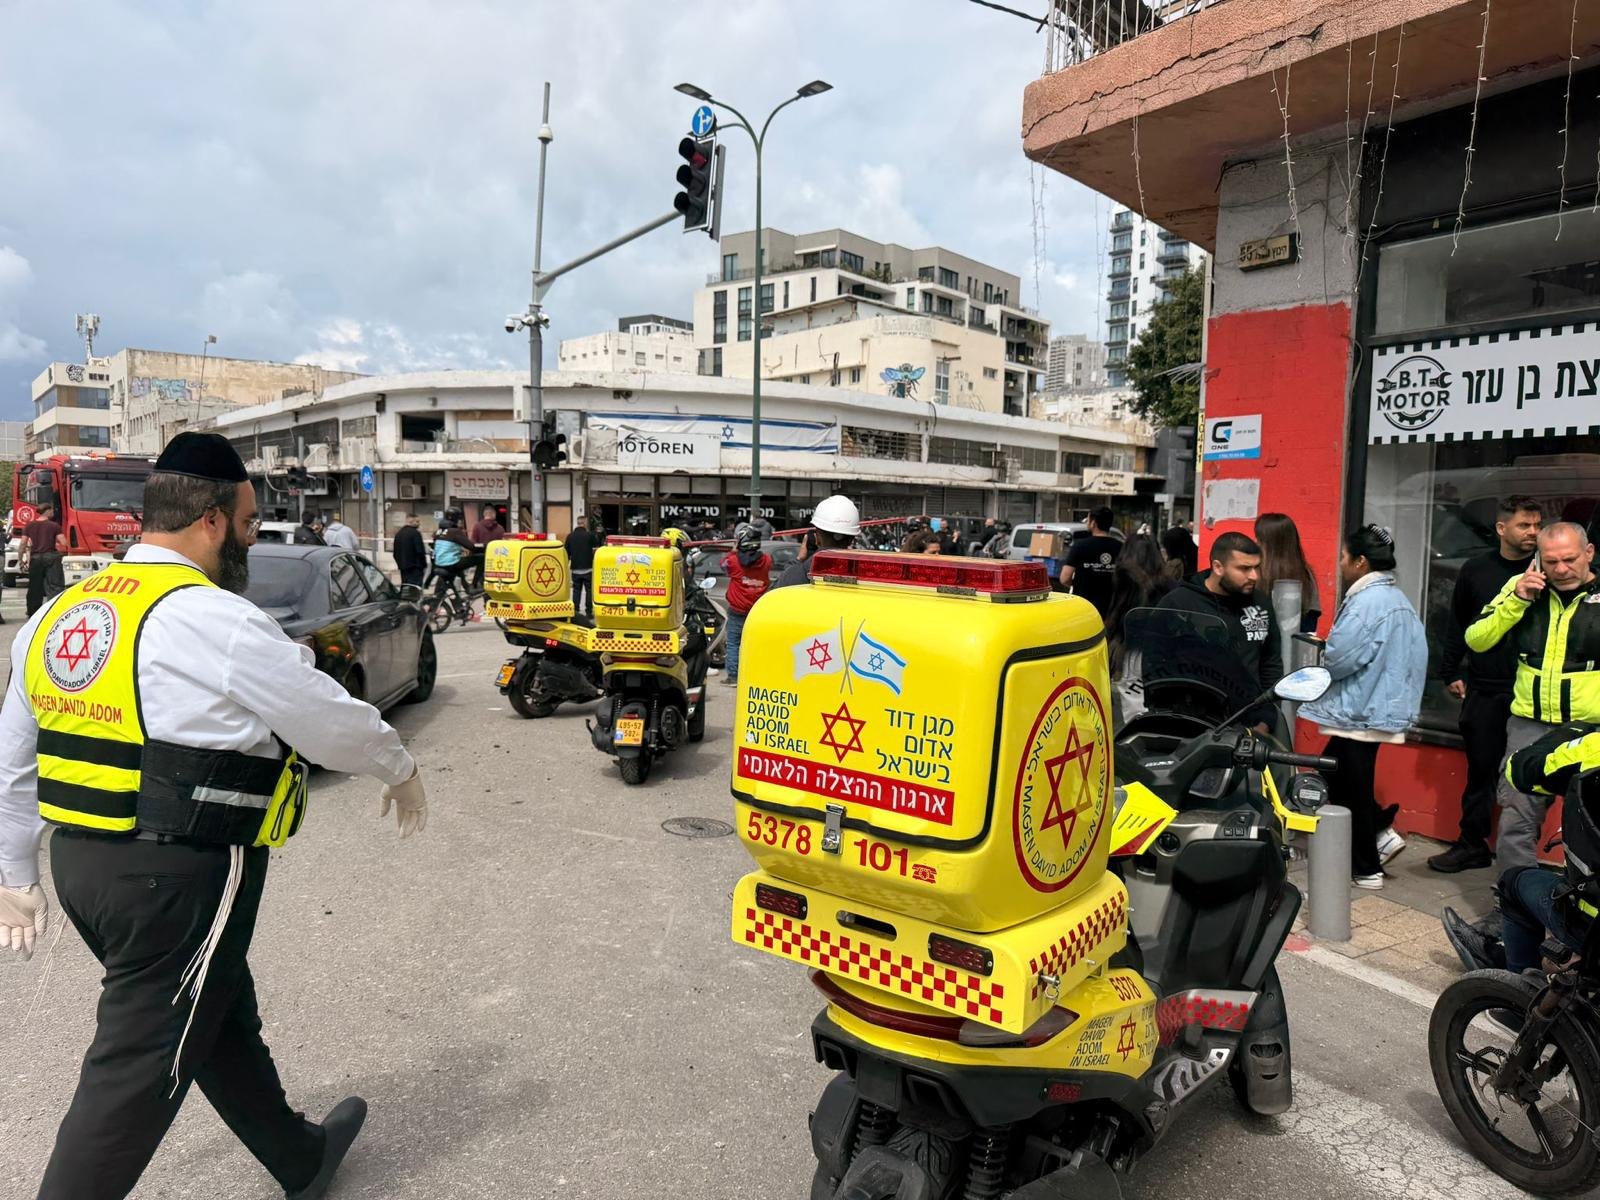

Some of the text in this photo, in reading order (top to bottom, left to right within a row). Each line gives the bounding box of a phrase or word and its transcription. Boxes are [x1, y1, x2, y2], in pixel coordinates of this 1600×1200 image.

[1399, 368, 1431, 388] B.T
[1462, 367, 1504, 404] עזר
[1516, 364, 1541, 409] בן
[1376, 390, 1451, 410] MOTOR
[453, 477, 506, 488] מטבחים
[660, 505, 720, 518] טרייד-אין
[82, 575, 140, 595] חובש
[601, 607, 653, 616] 5470 101
[748, 686, 798, 706] MAGEN
[57, 696, 86, 717] DAVID
[89, 704, 122, 724] ADOM
[747, 701, 790, 720] DAVID
[747, 716, 789, 735] ADOM
[884, 708, 954, 736] מגן דוד
[746, 729, 810, 754] N ISRAEL
[904, 735, 953, 760] אדום
[876, 748, 950, 784] בישראל
[744, 754, 946, 816] ארגון ההצלה הלאומי
[1023, 785, 1036, 853] MAGEN
[1031, 850, 1057, 877] DAVID
[1059, 838, 1087, 876] ADOM
[1088, 819, 1096, 838] IN
[747, 811, 908, 877] 5378 101
[1109, 976, 1142, 1001] 5378
[1088, 1016, 1115, 1030] MAGEN
[1080, 1029, 1106, 1041] DAVID
[1075, 1042, 1102, 1055] ADOM
[1069, 1054, 1110, 1067] IN ISRAEL
